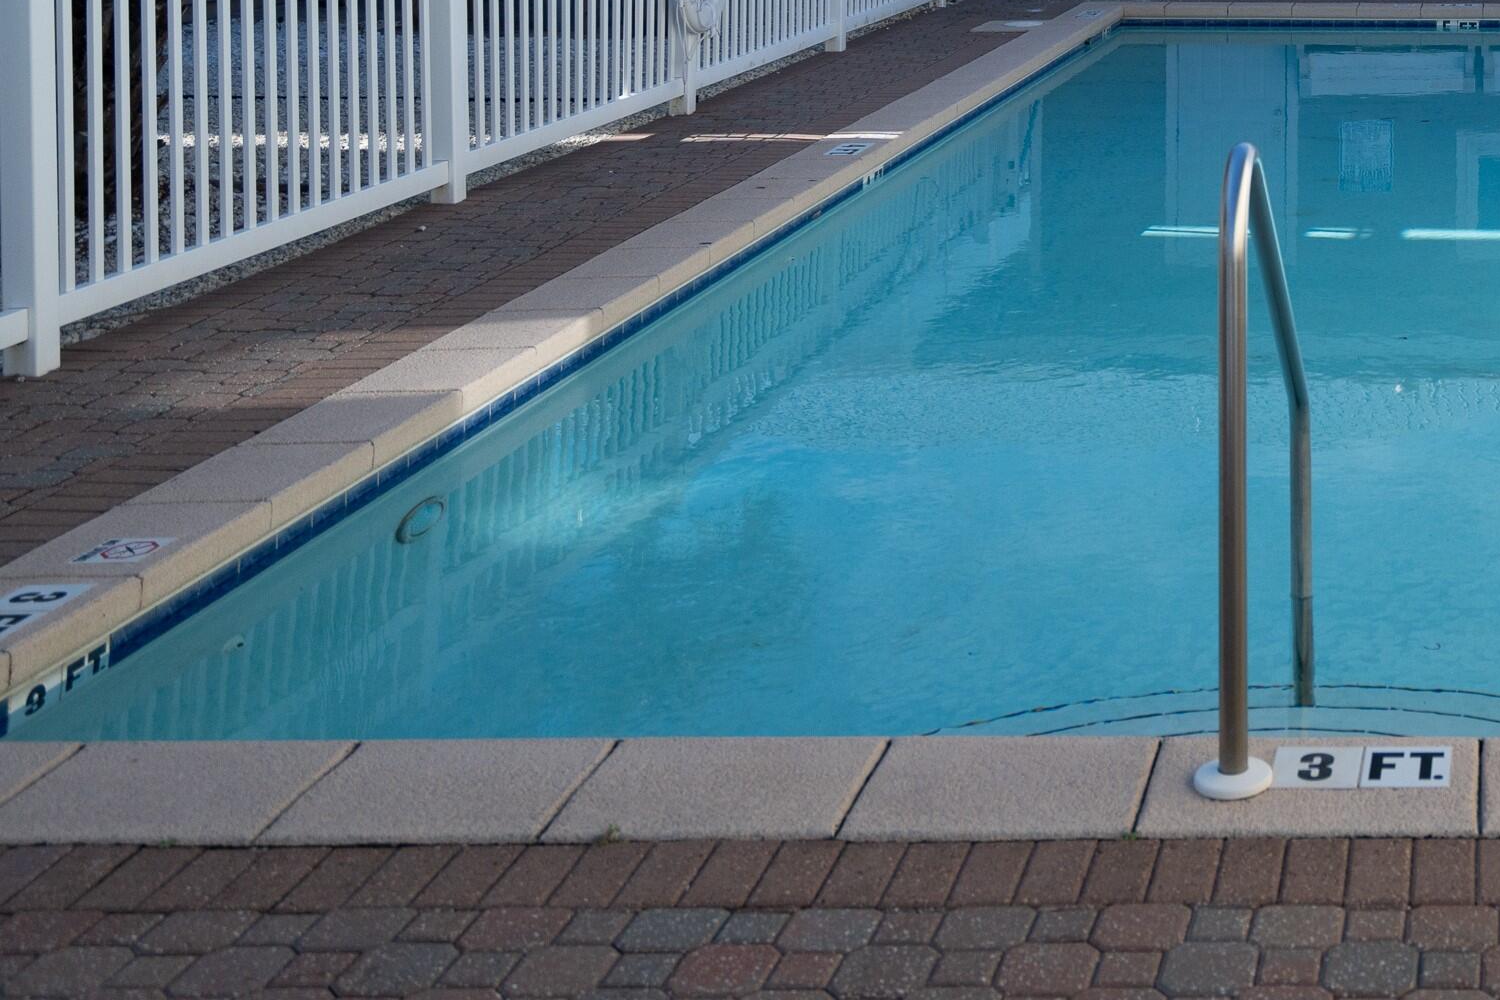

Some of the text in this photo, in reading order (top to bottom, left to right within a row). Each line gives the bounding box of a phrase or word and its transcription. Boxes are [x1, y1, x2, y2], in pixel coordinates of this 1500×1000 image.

[8, 591, 68, 603] 3
[1297, 752, 1445, 782] 3 FT.
